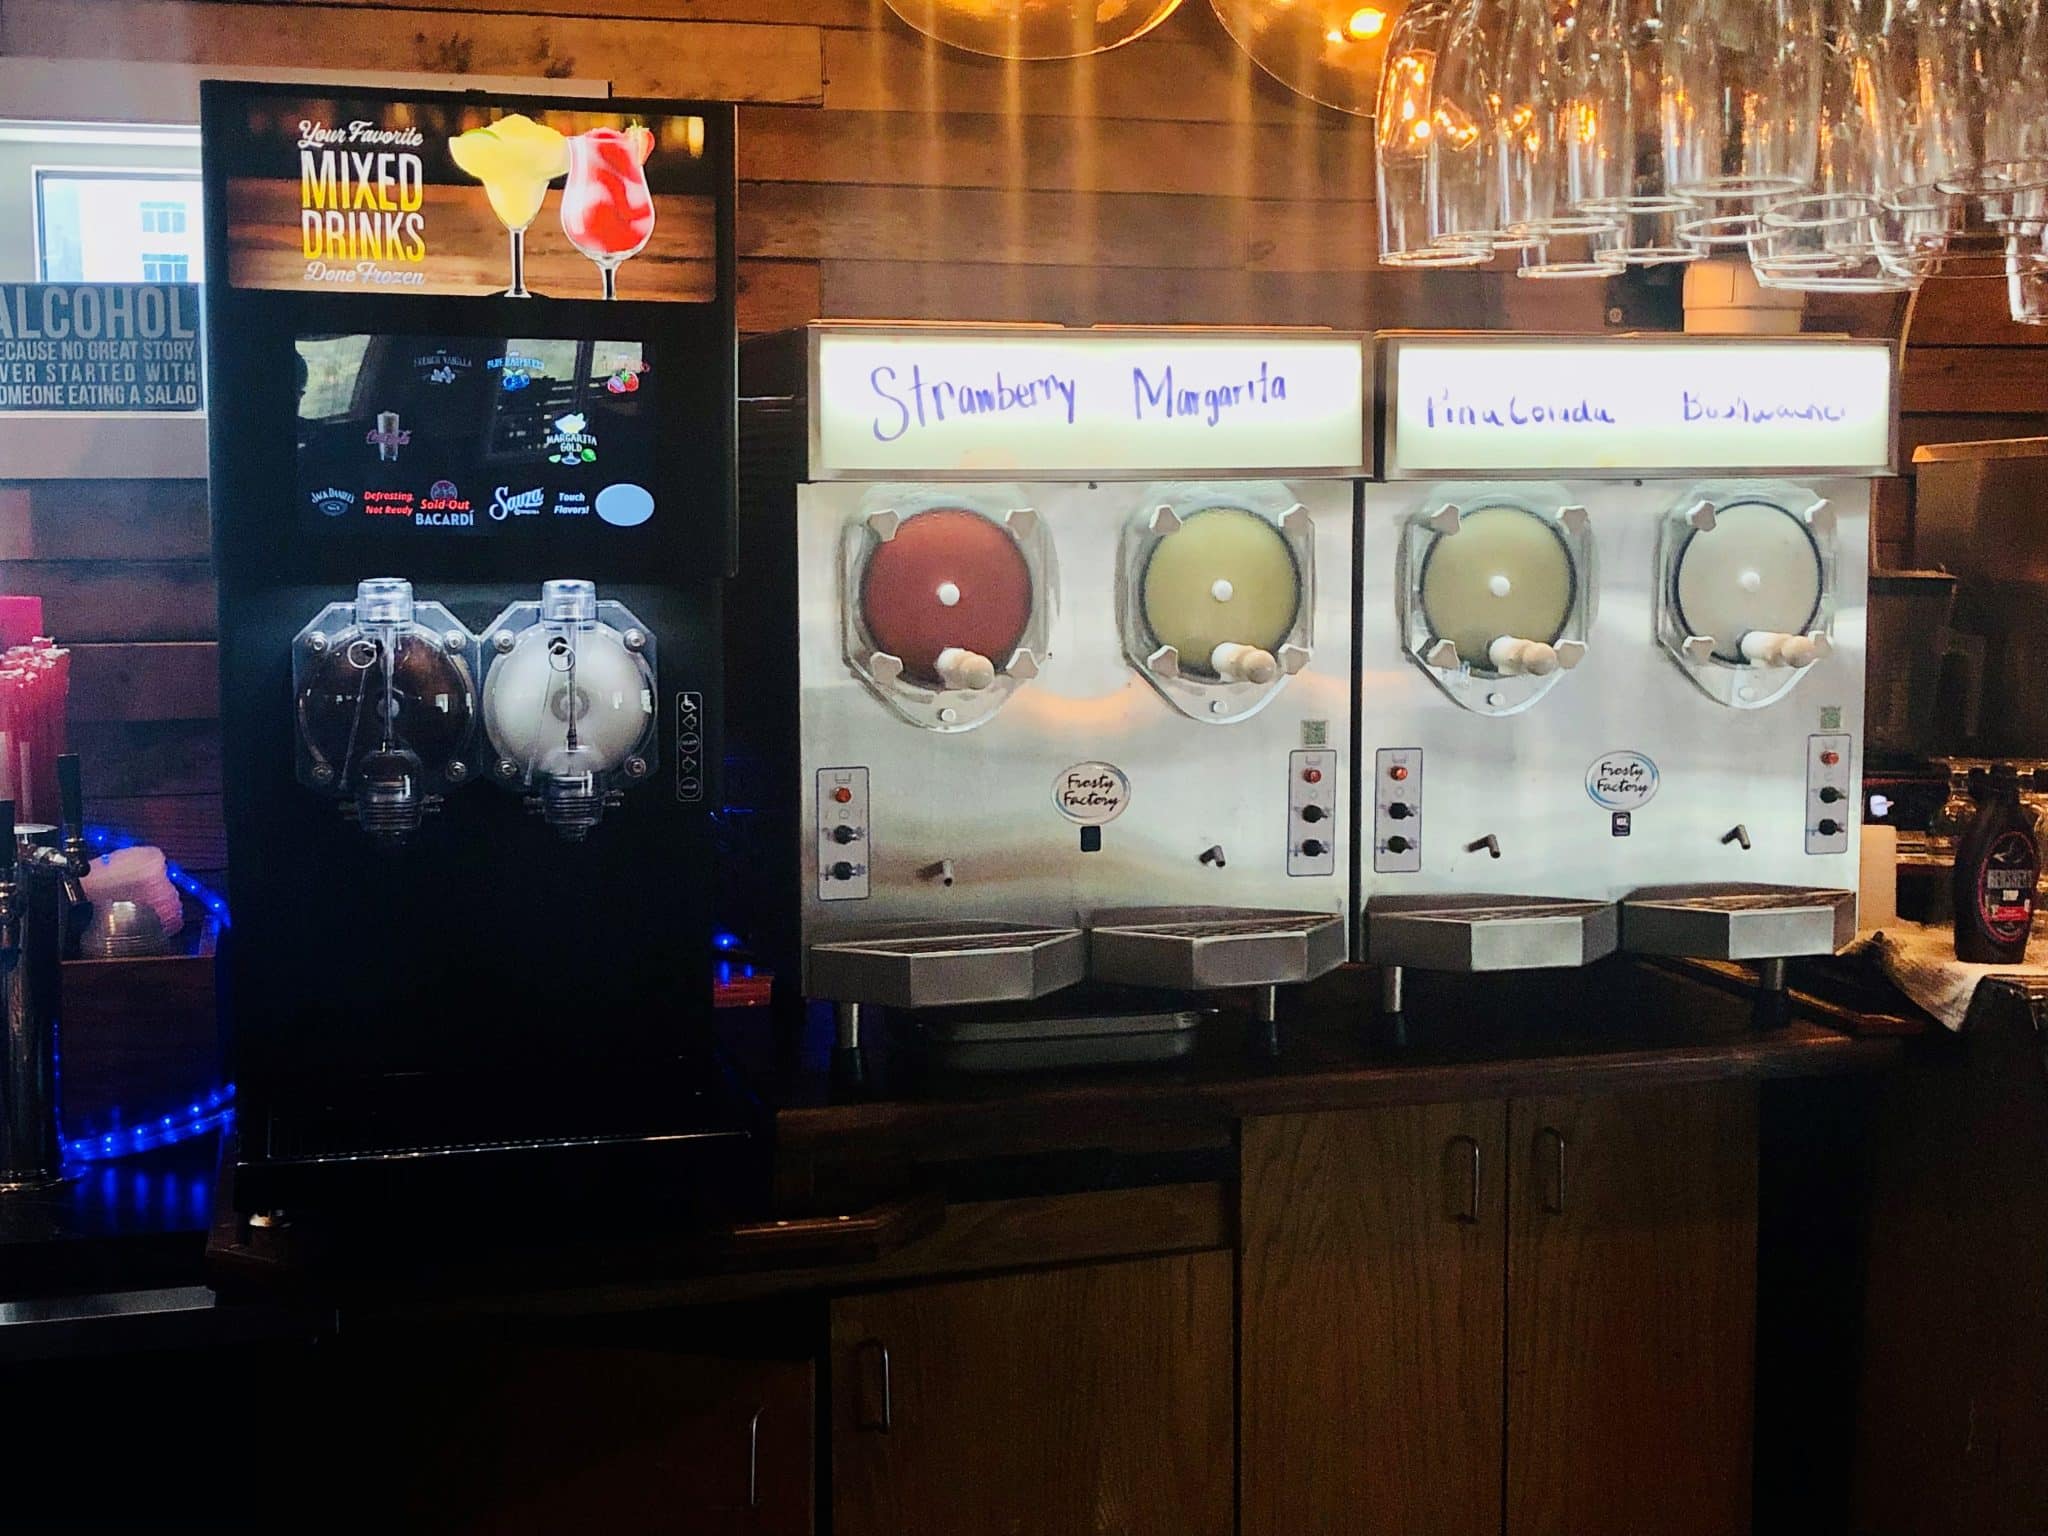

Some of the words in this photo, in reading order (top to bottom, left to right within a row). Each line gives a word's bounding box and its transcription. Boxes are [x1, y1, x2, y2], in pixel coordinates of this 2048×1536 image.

[297, 120, 347, 148] Your
[348, 120, 424, 147] Favorite
[300, 149, 424, 212] MIXED
[301, 209, 426, 263] DRINKS
[303, 261, 357, 281] Done
[355, 261, 425, 286] Frozen
[0, 286, 195, 339] ALCOHOL
[61, 341, 84, 360] NO
[88, 341, 138, 361] GREAT
[142, 341, 194, 361] STORY
[46, 363, 136, 383] STARTED
[145, 363, 197, 383] WITH
[68, 385, 125, 405] EATING
[129, 386, 141, 405] A
[144, 385, 197, 405] SALAD
[870, 364, 1076, 442] Strawberry
[1132, 361, 1288, 427] Margarita
[546, 433, 598, 446] MARGARITA
[560, 443, 583, 453] GOLD
[420, 498, 446, 511] Sold
[558, 492, 586, 502] Touch
[365, 505, 383, 515] Not
[385, 505, 414, 517] Ready
[553, 505, 590, 516] Flavors!
[1600, 761, 1645, 782] Frosty
[1067, 773, 1116, 795] Frosty
[1596, 777, 1649, 798] Factory
[1063, 790, 1120, 812] Factory
